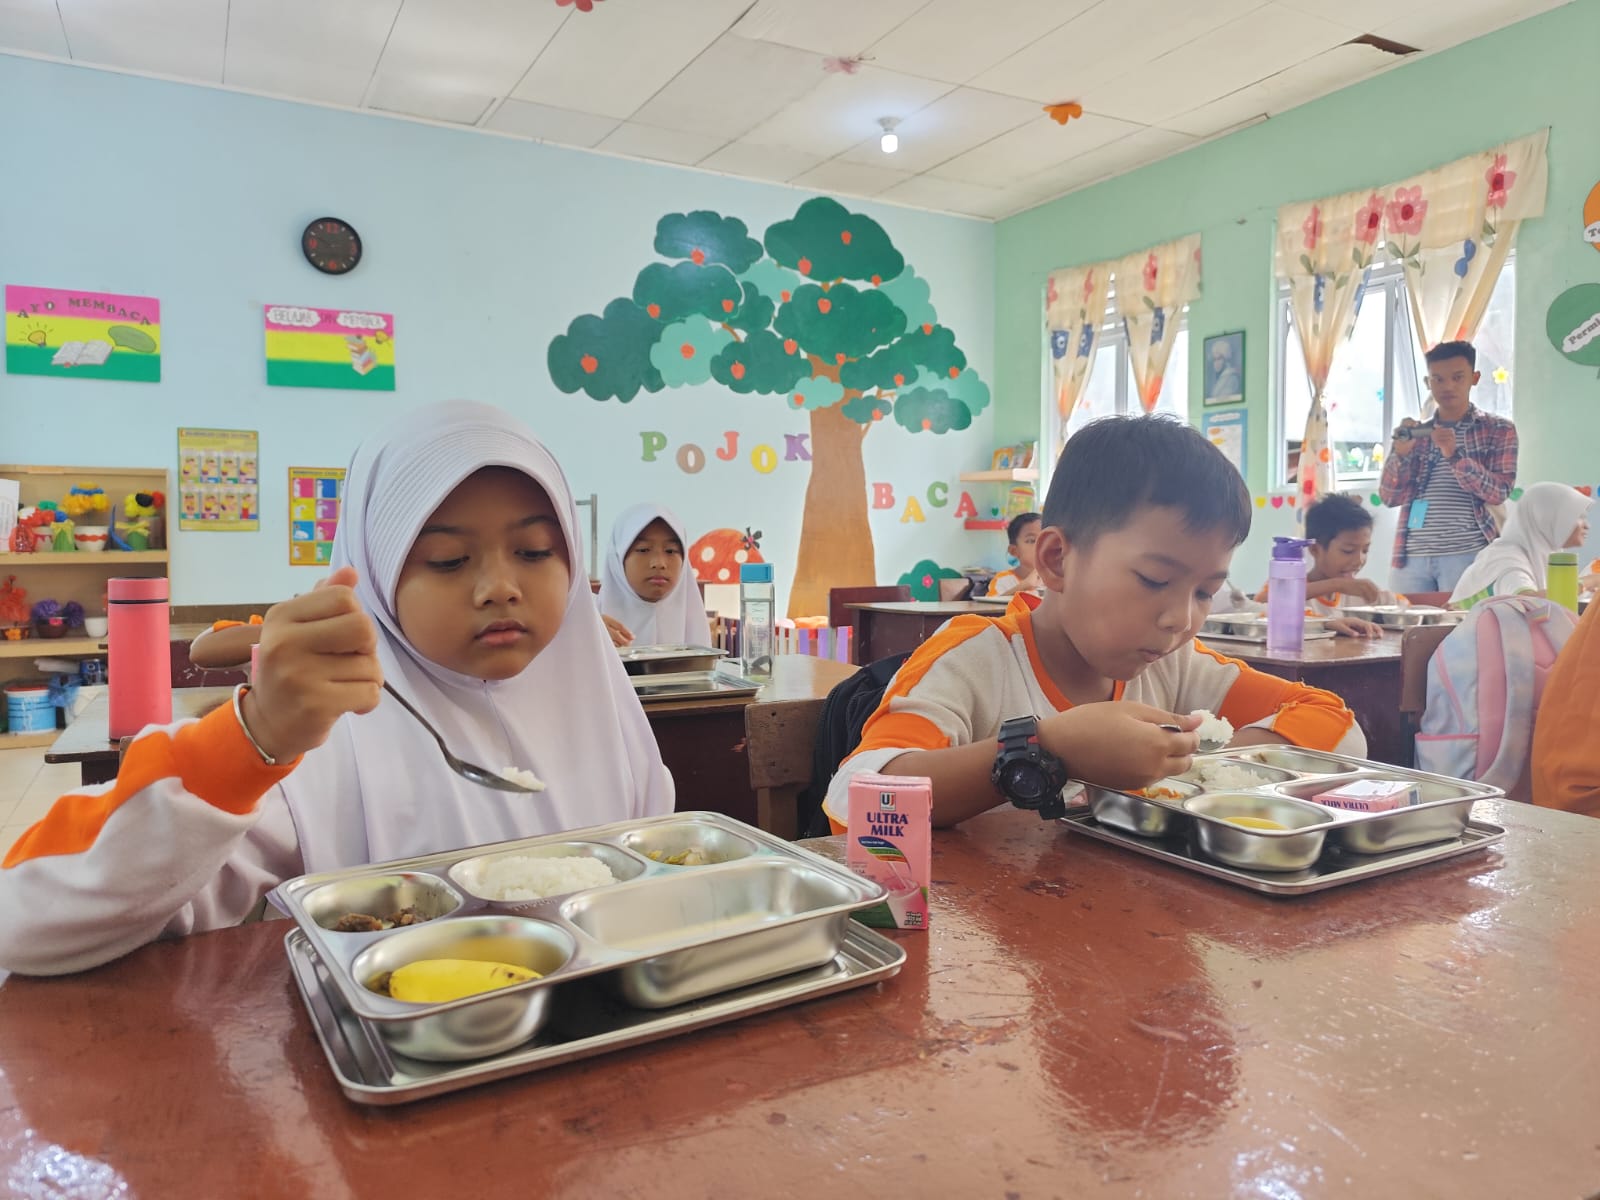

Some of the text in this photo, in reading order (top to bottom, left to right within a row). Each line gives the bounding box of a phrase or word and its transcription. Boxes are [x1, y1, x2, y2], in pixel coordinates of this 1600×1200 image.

[17, 298, 151, 325] AYO MEMBACA
[639, 431, 979, 523] POJOK BACA
[867, 812, 908, 824] ULTRA
[871, 825, 904, 837] MILK
